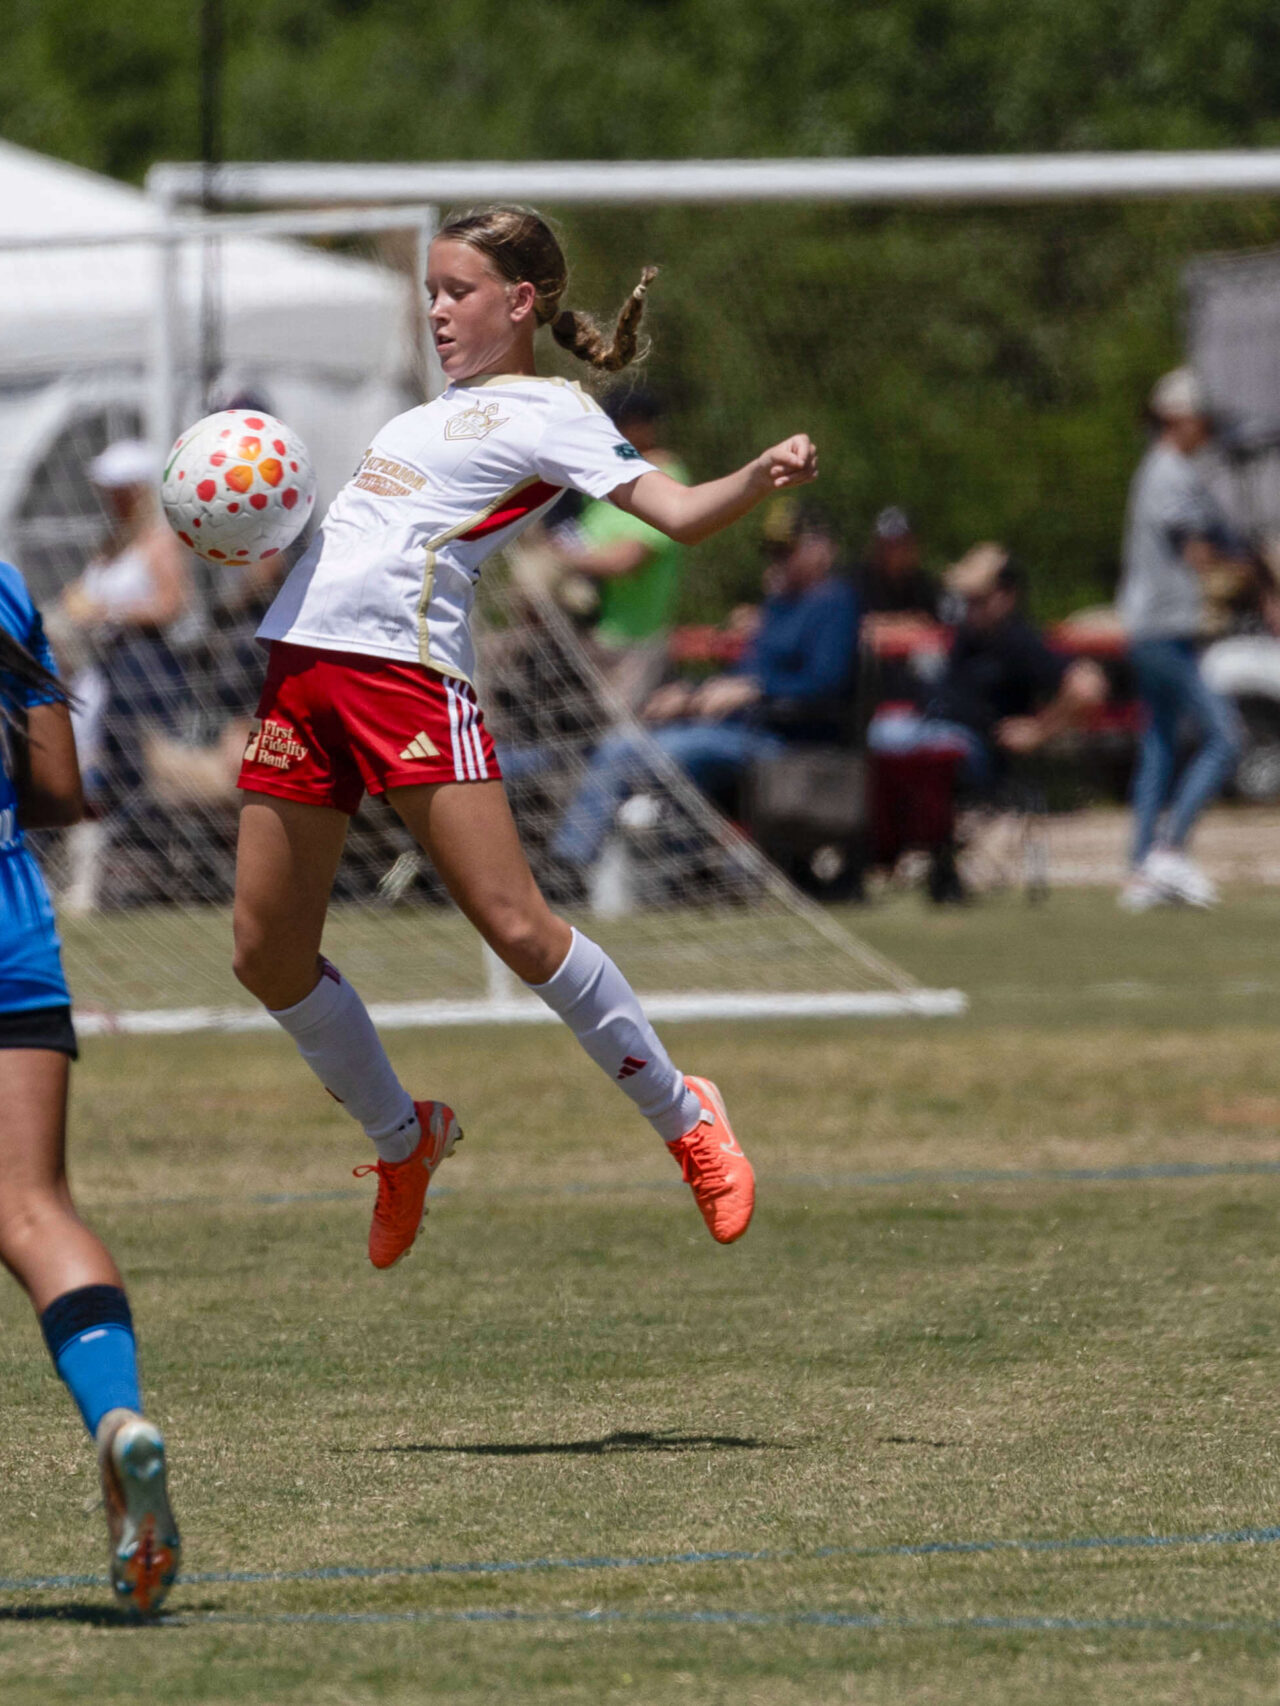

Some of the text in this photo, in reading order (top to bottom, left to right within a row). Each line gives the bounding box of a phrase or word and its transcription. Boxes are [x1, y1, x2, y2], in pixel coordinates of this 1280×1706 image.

[264, 719, 294, 740] First
[261, 734, 308, 761] Fidelity
[257, 748, 290, 770] Bank
